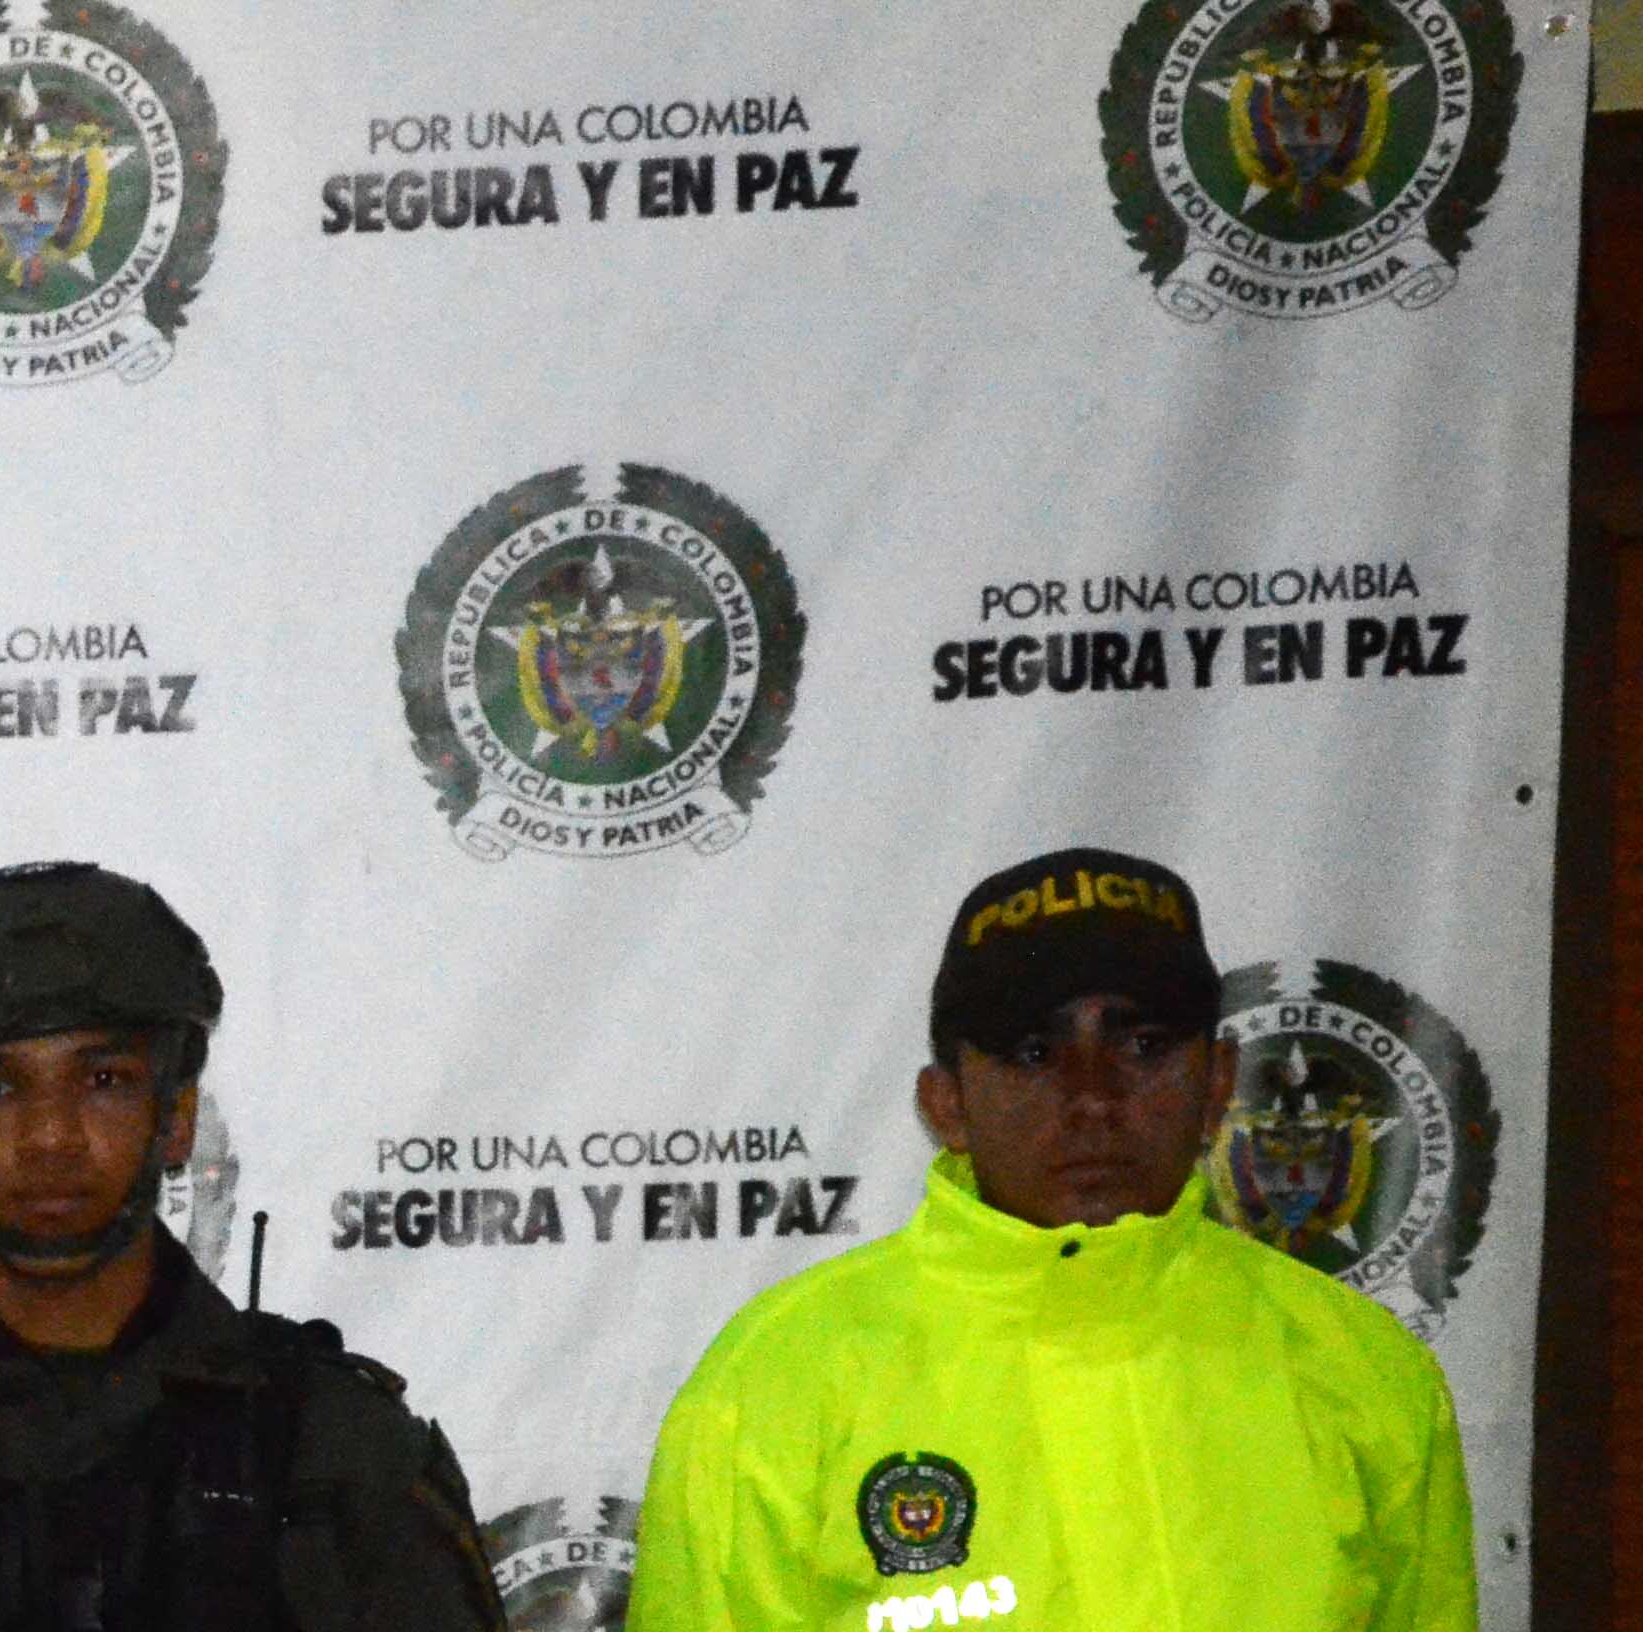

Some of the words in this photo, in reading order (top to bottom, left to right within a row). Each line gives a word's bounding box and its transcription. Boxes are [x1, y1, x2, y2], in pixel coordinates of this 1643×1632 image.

[9, 36, 52, 59] DE
[83, 51, 176, 206] COLOMBIA
[370, 114, 451, 154] POR
[466, 110, 564, 150] UNA
[576, 94, 810, 144] COLOMBIA
[321, 162, 561, 236] SEGURA
[577, 159, 621, 222] Y
[637, 153, 716, 219] EN
[735, 144, 862, 214] PAZ
[30, 246, 161, 339] NACIONAL
[29, 330, 131, 377] PATRIA
[584, 508, 626, 531] DE
[659, 523, 754, 677] COLOMBIA
[980, 579, 1068, 622] POR
[1081, 574, 1177, 617] UNA
[1183, 559, 1421, 613] COLOMBIA
[932, 627, 1166, 702] SEGURA
[1182, 623, 1227, 690] Y
[1242, 619, 1325, 686] EN
[1344, 611, 1470, 681] PAZ
[79, 674, 198, 735] PAZ
[603, 713, 741, 809] NACIONAL
[602, 801, 706, 848] PATRIA
[378, 1136, 459, 1175] POR
[471, 1136, 569, 1173] UNA
[580, 1125, 809, 1168] COLOMBIA
[331, 1186, 565, 1252] SEGURA
[581, 1184, 623, 1243] Y
[641, 1180, 719, 1243] EN
[737, 1174, 860, 1239] PAZ
